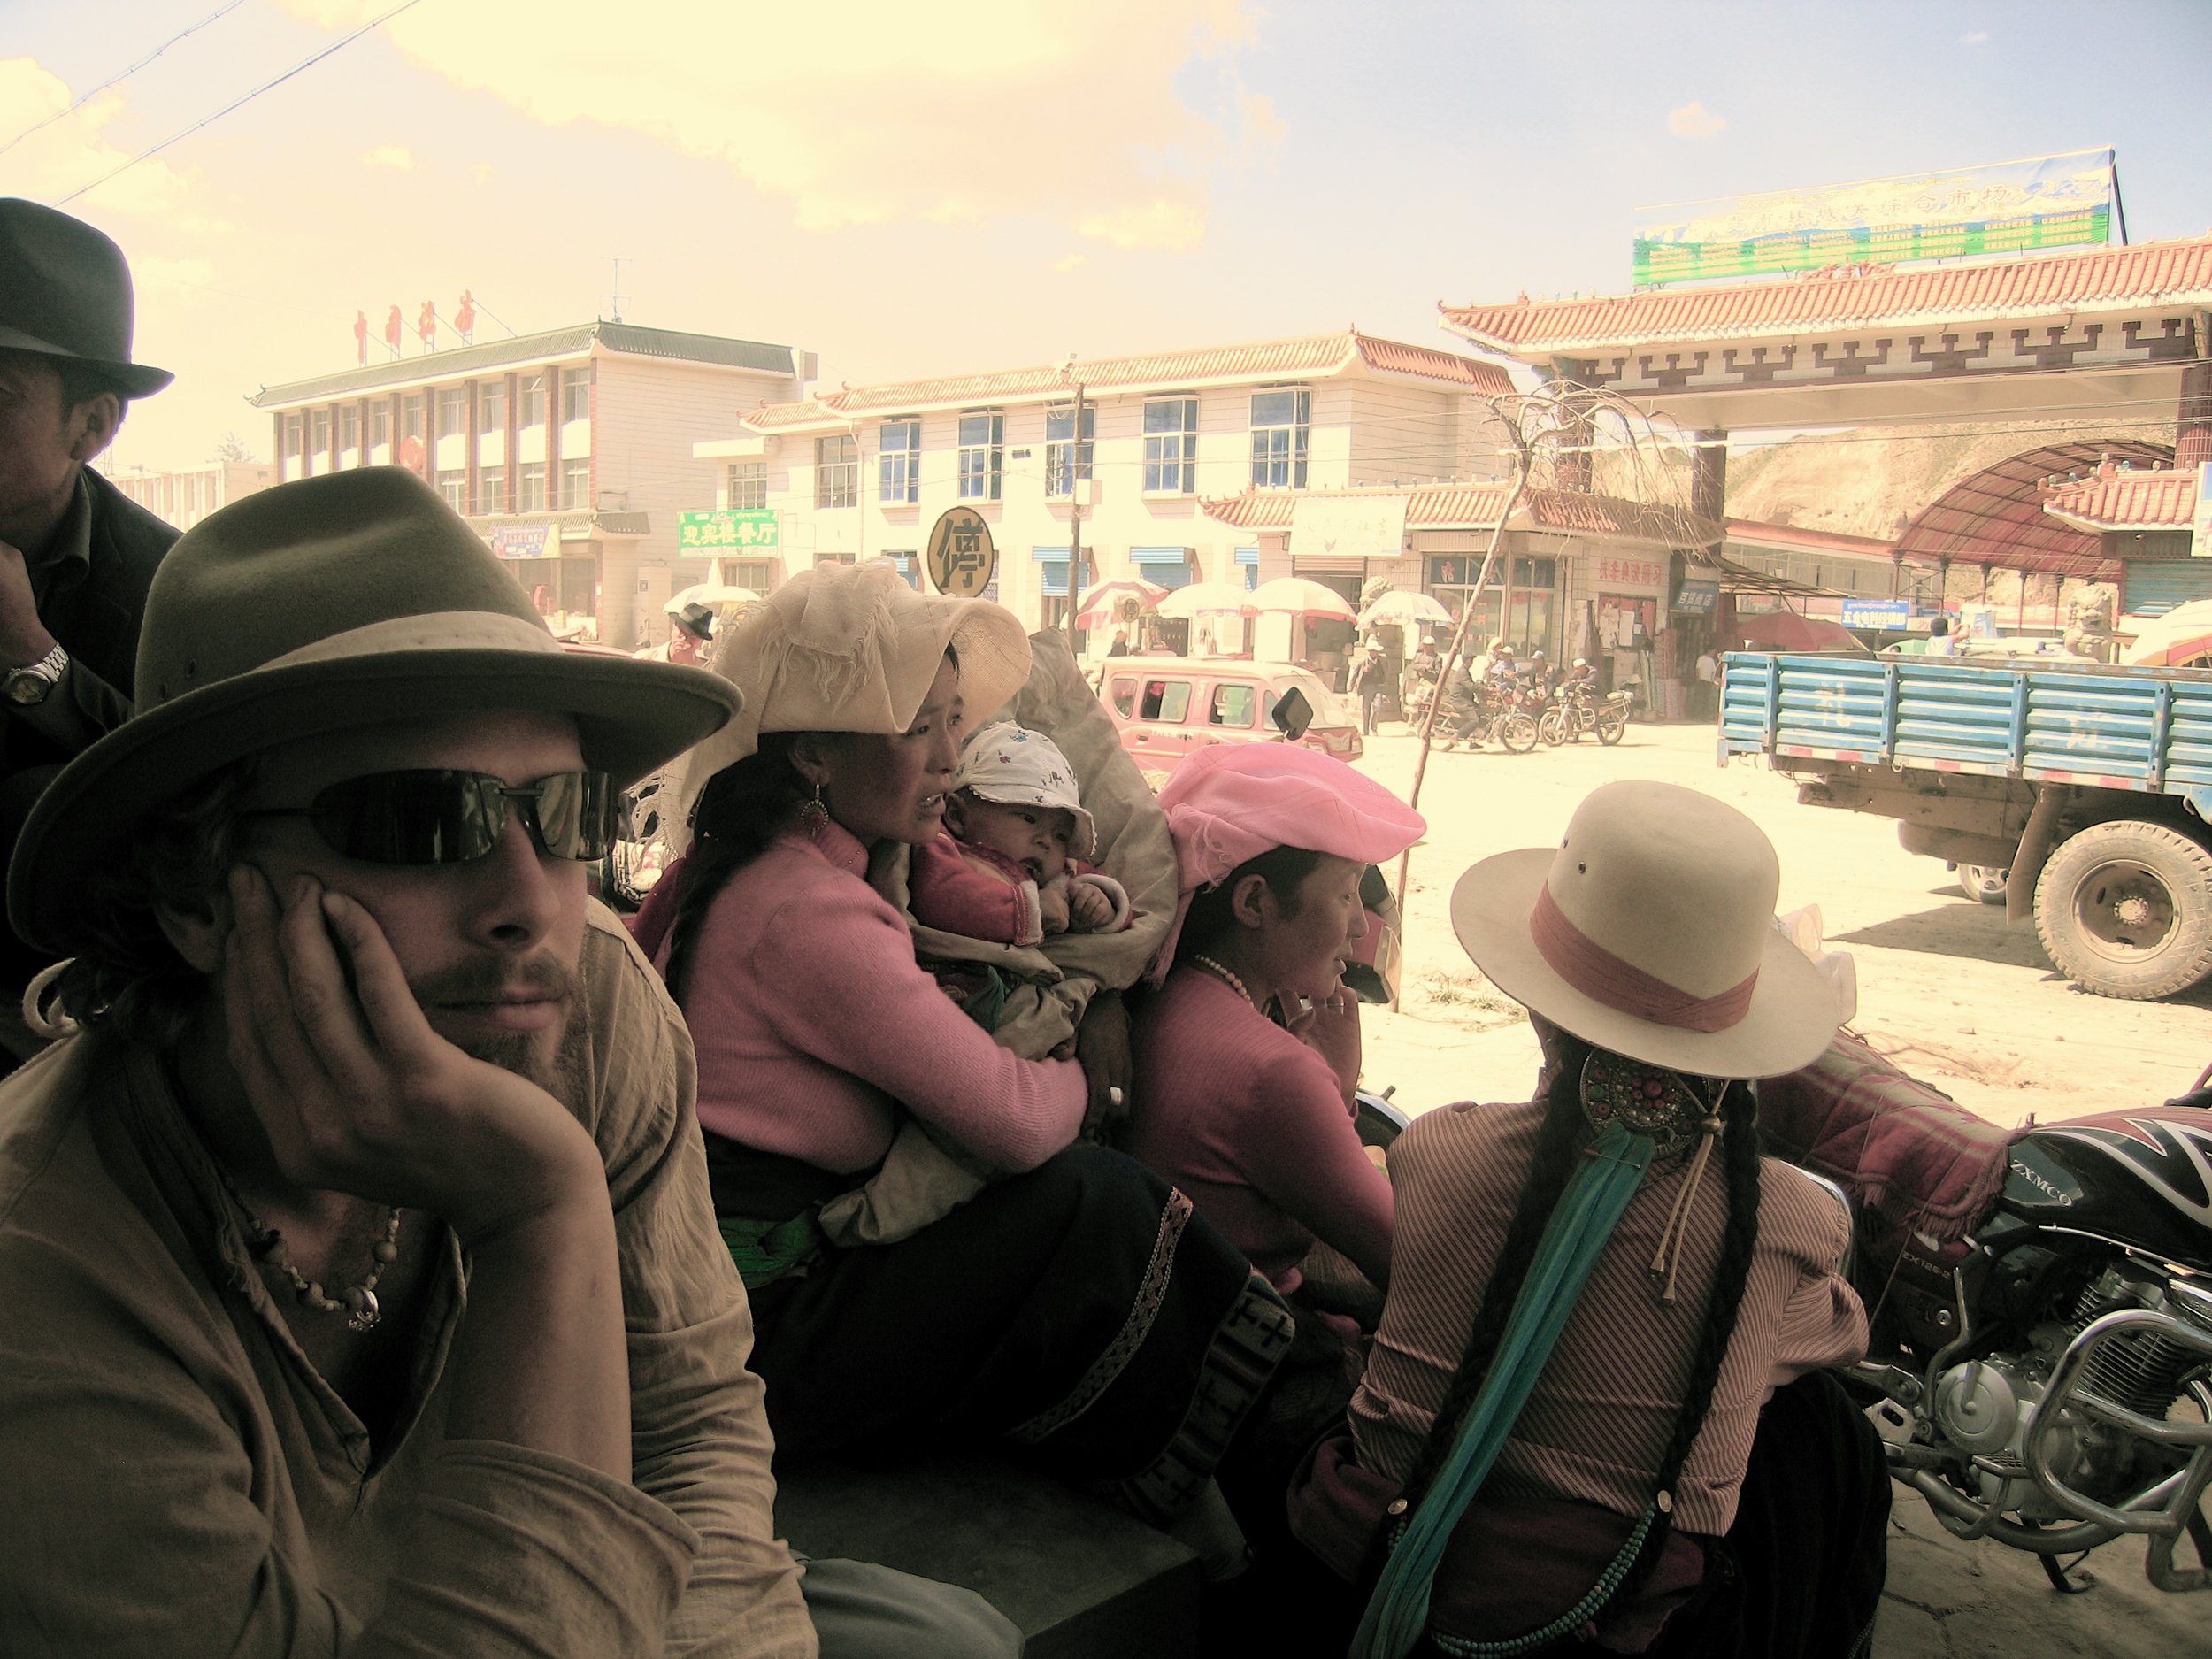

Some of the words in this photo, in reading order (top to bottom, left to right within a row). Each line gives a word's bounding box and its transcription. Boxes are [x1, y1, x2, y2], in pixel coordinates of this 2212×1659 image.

[682, 522, 777, 545] 迎宾楼餐厅
[937, 518, 986, 588] 停
[2010, 1159, 2073, 1207] ZXMCO
